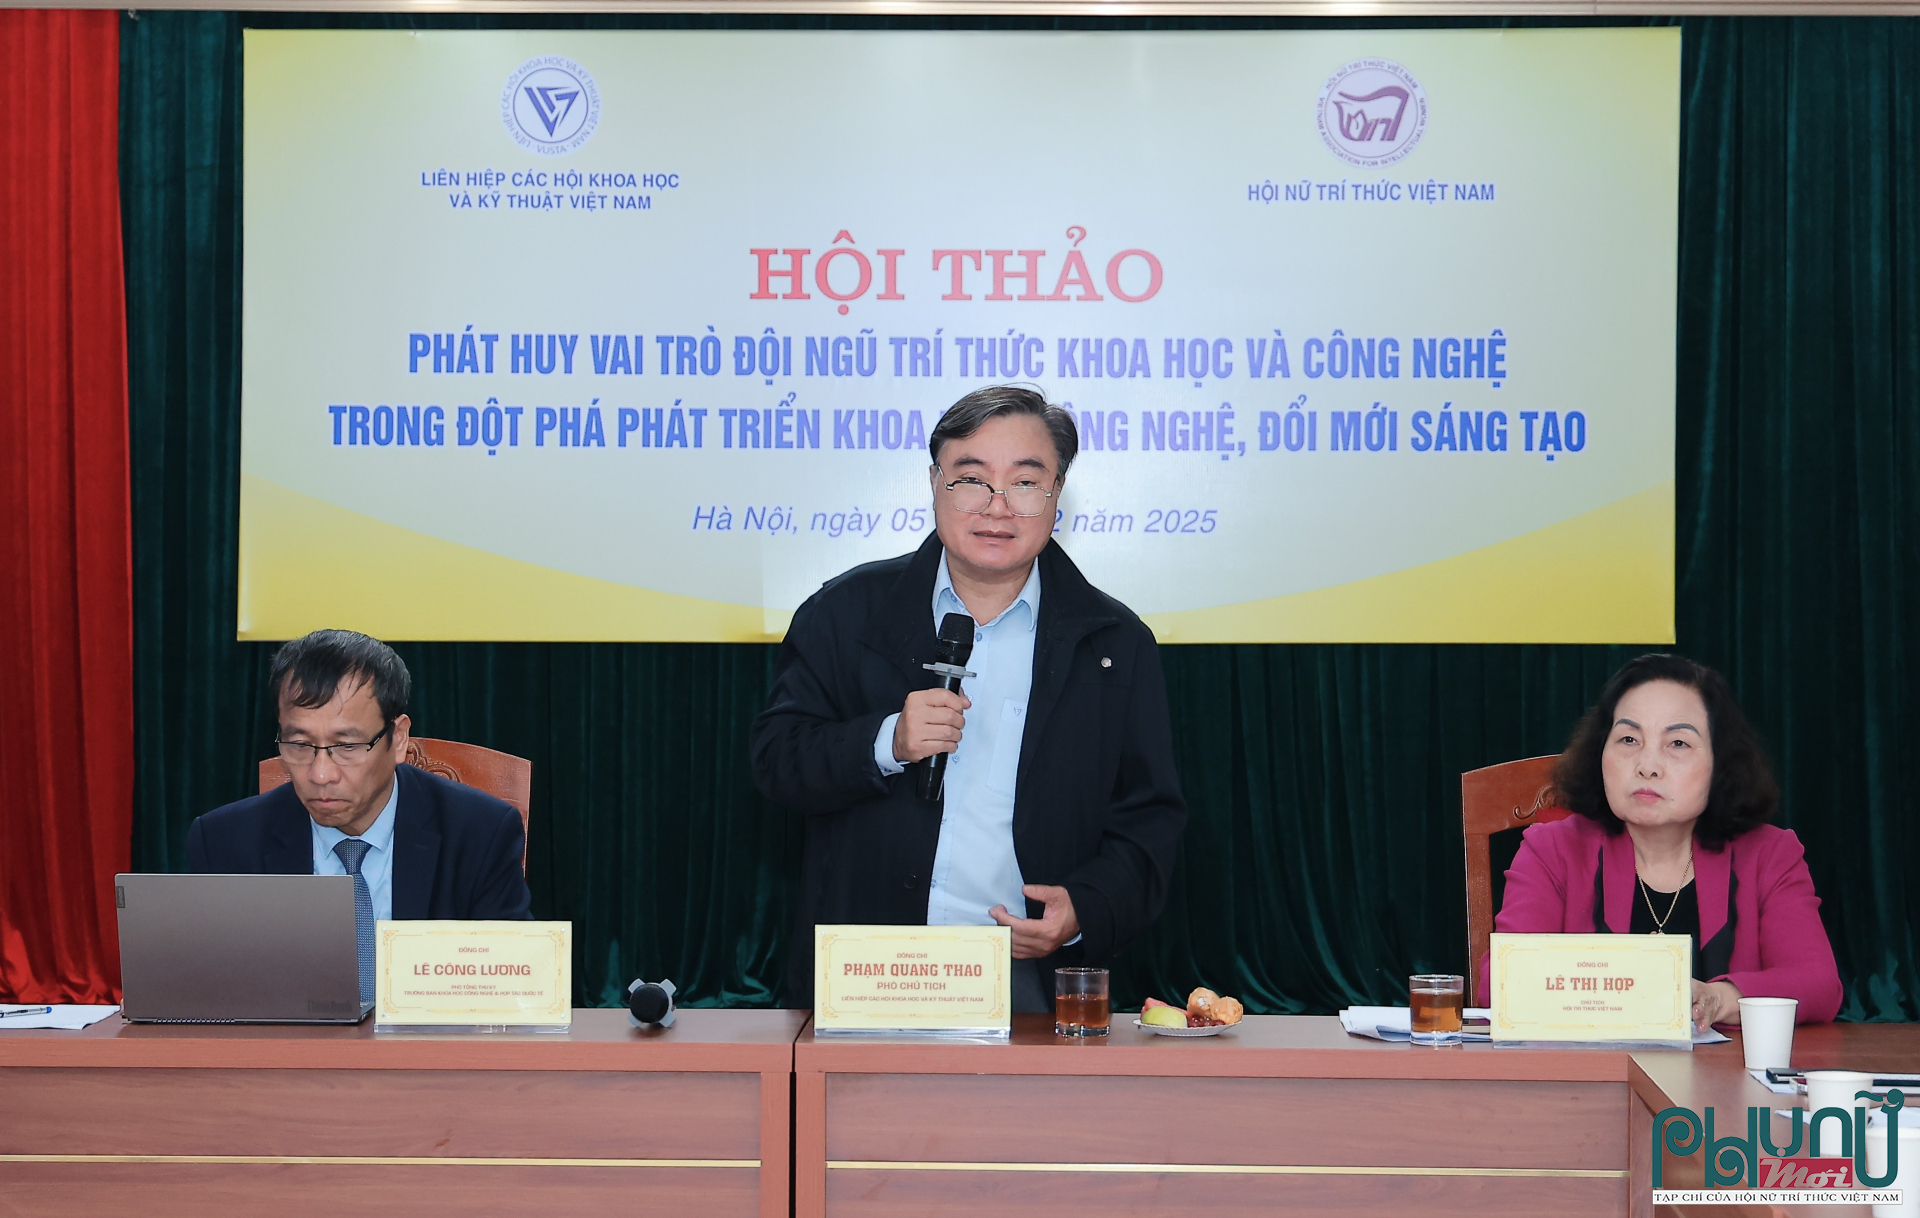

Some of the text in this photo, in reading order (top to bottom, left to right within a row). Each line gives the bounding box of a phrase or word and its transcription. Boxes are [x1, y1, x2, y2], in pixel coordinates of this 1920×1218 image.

[537, 145, 567, 154] VUSTA
[421, 168, 680, 191] LIÊN HIỆP CÁC HỘI KHOA HỌC
[449, 190, 651, 212] VÀ KỸ THUẬT VIỆT NAM
[1248, 179, 1495, 205] HỘI NỮ TRÍ THỨC VIỆT NAM
[749, 225, 1164, 316] HỘI THẢO
[408, 324, 1507, 388] PHÁT HUY VAI TRÒ ĐỘI NGŨ TRÍ THỨC KHOA HỌC VÀ CÔNG NGHỆ
[328, 404, 444, 447] TRONG
[456, 397, 523, 456] ĐỘT
[535, 399, 605, 447] PHÁ
[617, 399, 708, 448] PHÁT
[718, 391, 820, 450] TRIỂN
[833, 409, 926, 450] KHOA
[1142, 402, 1246, 460] NGHỆ,
[1258, 394, 1317, 451] ĐỔI
[1330, 402, 1397, 452] MỚI
[1411, 402, 1507, 452] SÁNG
[1520, 411, 1586, 461] TẠO
[692, 505, 732, 532] Hà
[743, 506, 798, 536] Nội,
[810, 507, 880, 538] ngày
[890, 508, 926, 533] 05
[1072, 508, 1134, 533] năm
[1143, 509, 1218, 534] 2025
[414, 962, 531, 976] LÊ CÔNG LƯƠNG
[844, 963, 982, 979] PHẠM QUANG THAO
[1546, 974, 1634, 994] LÊ THỊ HỢP
